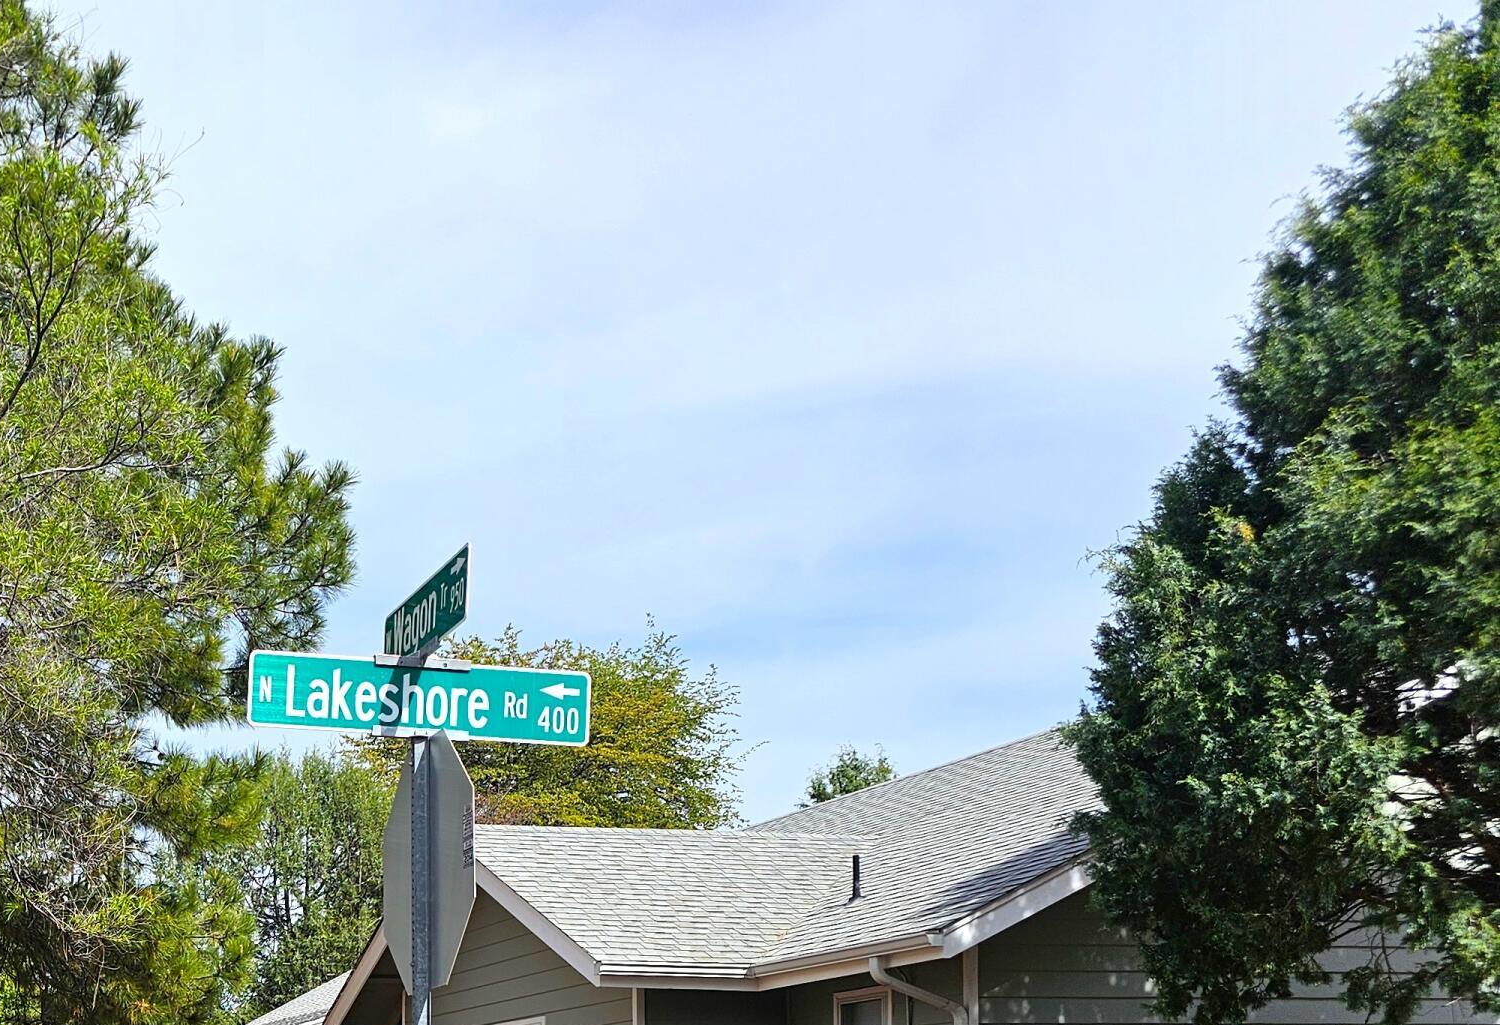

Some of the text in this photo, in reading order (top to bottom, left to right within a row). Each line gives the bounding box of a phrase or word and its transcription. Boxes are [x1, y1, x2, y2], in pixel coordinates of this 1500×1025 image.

[394, 590, 437, 656] Wagon
[440, 582, 448, 610] Tr
[450, 577, 464, 614] 950
[259, 663, 579, 735] N Lakeshore Rd 400
